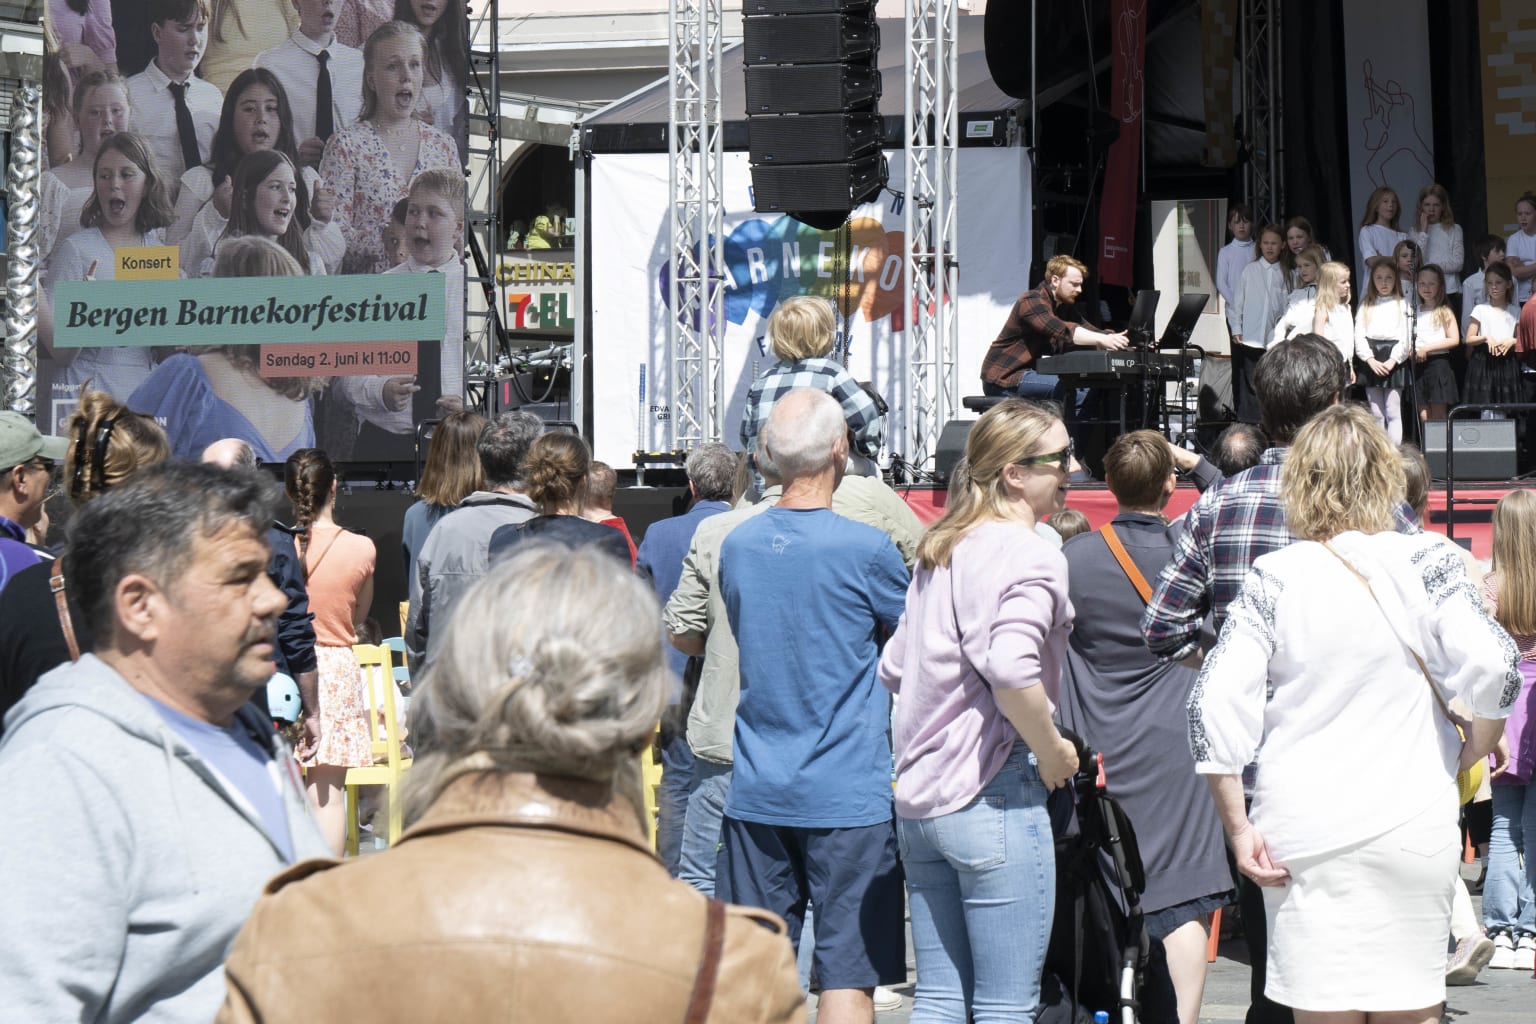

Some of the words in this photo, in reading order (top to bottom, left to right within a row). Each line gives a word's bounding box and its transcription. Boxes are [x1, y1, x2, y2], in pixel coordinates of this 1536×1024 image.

[122, 256, 171, 270] Konsert
[496, 262, 574, 280] CHINA
[66, 301, 168, 334] Bergen
[176, 293, 428, 331] Barnekorfestival
[266, 352, 315, 367] Søndag
[319, 352, 331, 366] 2.
[333, 351, 359, 367] juni
[362, 351, 374, 365] kl
[377, 350, 411, 364] 11:00
